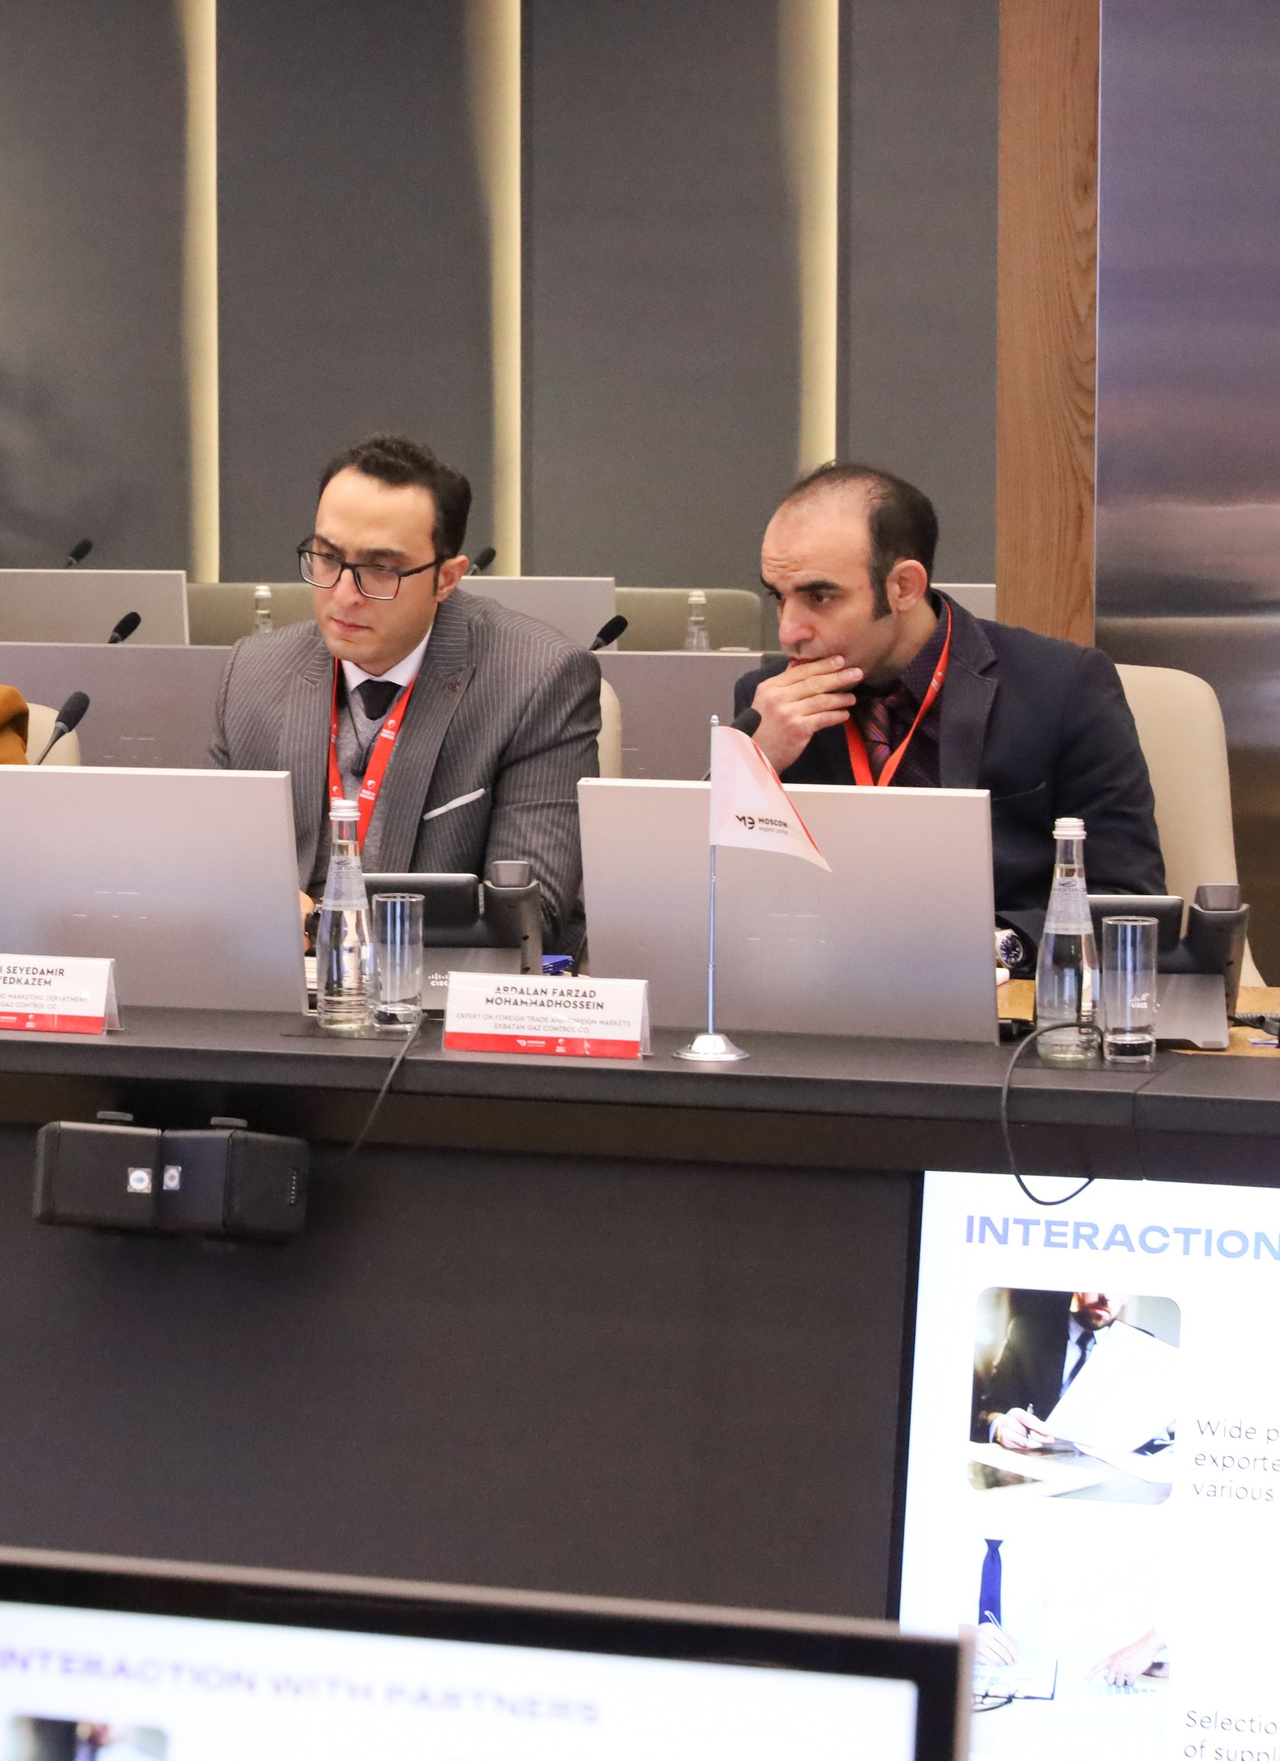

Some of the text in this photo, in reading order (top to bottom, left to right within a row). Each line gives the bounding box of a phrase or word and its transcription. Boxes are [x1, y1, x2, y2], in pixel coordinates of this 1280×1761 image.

[758, 817, 789, 828] MOSCOW
[6, 966, 65, 977] SEYEDAMIR
[8, 993, 44, 1001] MARKETING
[494, 986, 596, 999] ARDALAN FARZAD
[15, 1001, 45, 1009] CONTROL
[485, 996, 604, 1010] MOHAMMADHOSSEIN
[456, 1012, 482, 1020] EXPERT
[484, 1013, 494, 1021] ON
[495, 1014, 525, 1022] FOREIGN
[527, 1015, 549, 1023] TRADE
[599, 1018, 631, 1027] MARKETS
[543, 1025, 576, 1033] CONTROL
[965, 1215, 1280, 1261] INTERACTION
[1196, 1419, 1257, 1440] Wide
[1193, 1480, 1274, 1502] various
[1186, 1710, 1277, 1735] Selectio
[1184, 1739, 1208, 1759] of
